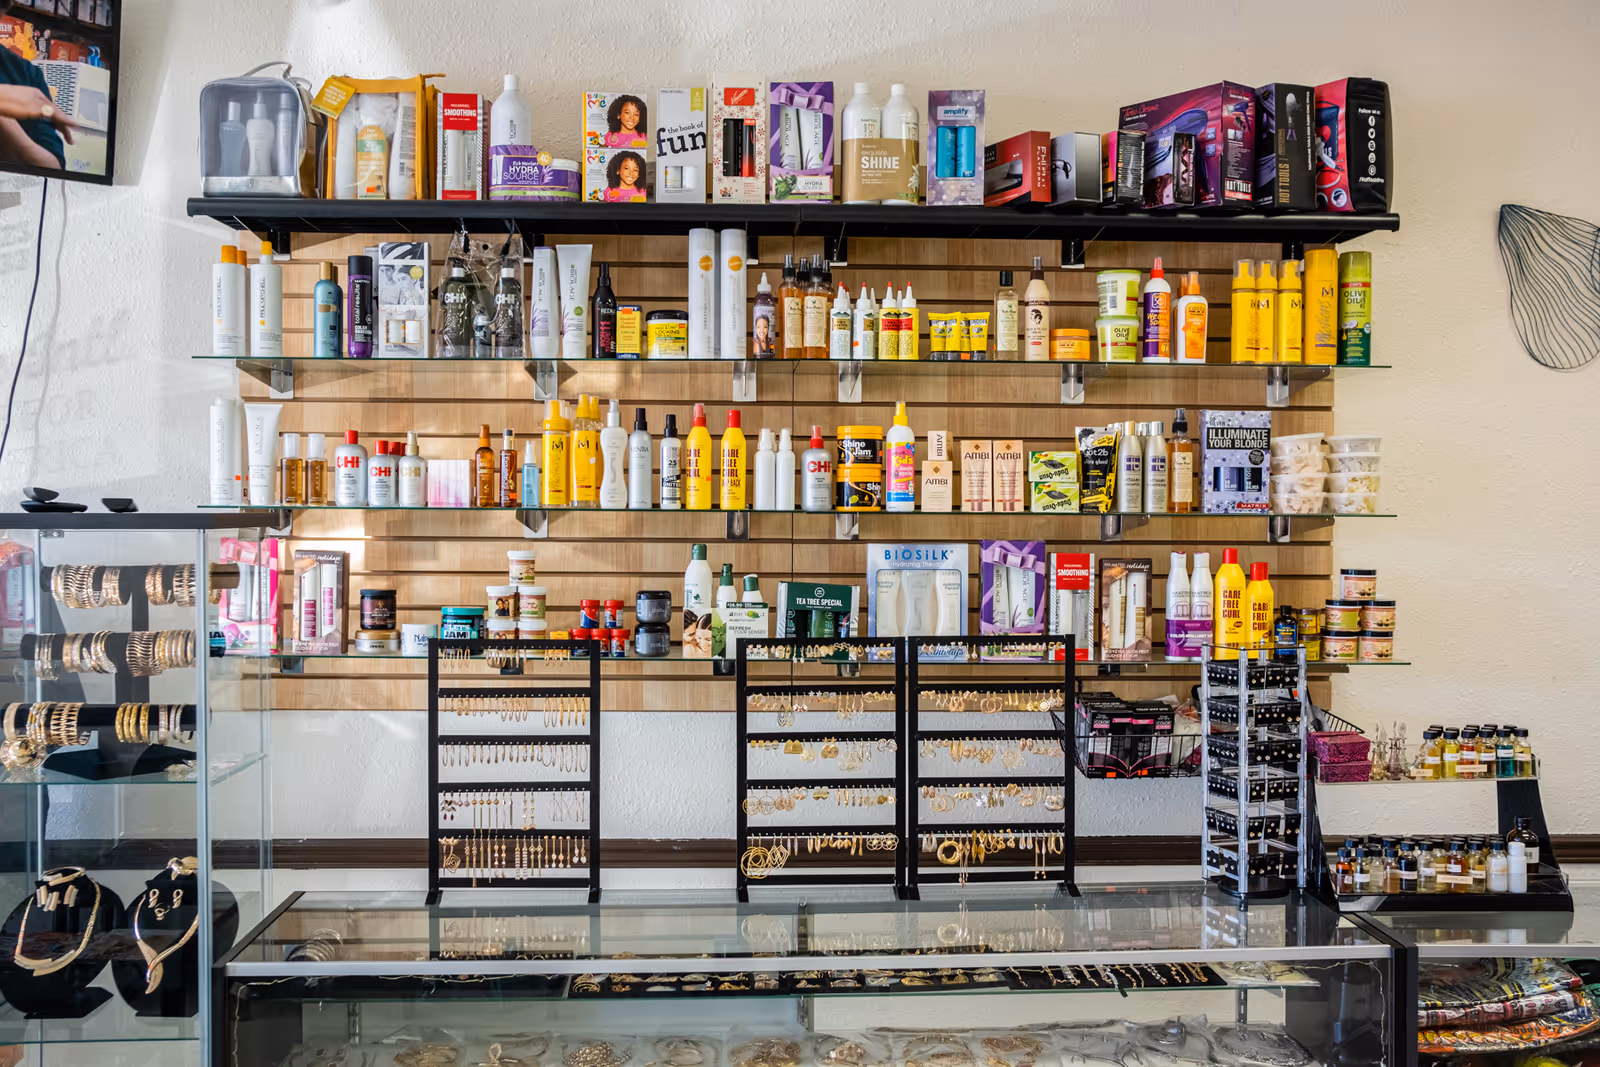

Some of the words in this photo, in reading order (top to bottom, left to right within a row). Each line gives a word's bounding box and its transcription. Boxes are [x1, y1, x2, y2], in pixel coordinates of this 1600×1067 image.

[444, 108, 477, 117] SMOOTHING
[680, 123, 696, 132] book
[656, 128, 706, 158] fun
[861, 156, 900, 169] SHINE
[509, 164, 539, 173] HYDRA
[503, 172, 539, 180] SOURCE
[1279, 163, 1290, 186] TOOLS
[1279, 188, 1290, 203] HOT
[1209, 430, 1268, 440] ILLUMINATE
[1209, 440, 1232, 448] YOUR
[1234, 440, 1268, 448] BLONDE
[686, 449, 700, 458] CARE
[722, 449, 739, 458] CARE
[336, 456, 360, 468] CHI
[808, 461, 831, 472] CHI
[370, 467, 392, 476] CHI
[400, 467, 420, 476] CHI
[1038, 468, 1069, 480] Dudu-Osun
[1042, 498, 1072, 511] Dudu-Osun
[1222, 590, 1240, 599] CARE
[1222, 600, 1239, 609] FREE
[1222, 610, 1240, 618] CURL
[1252, 612, 1267, 621] FREE
